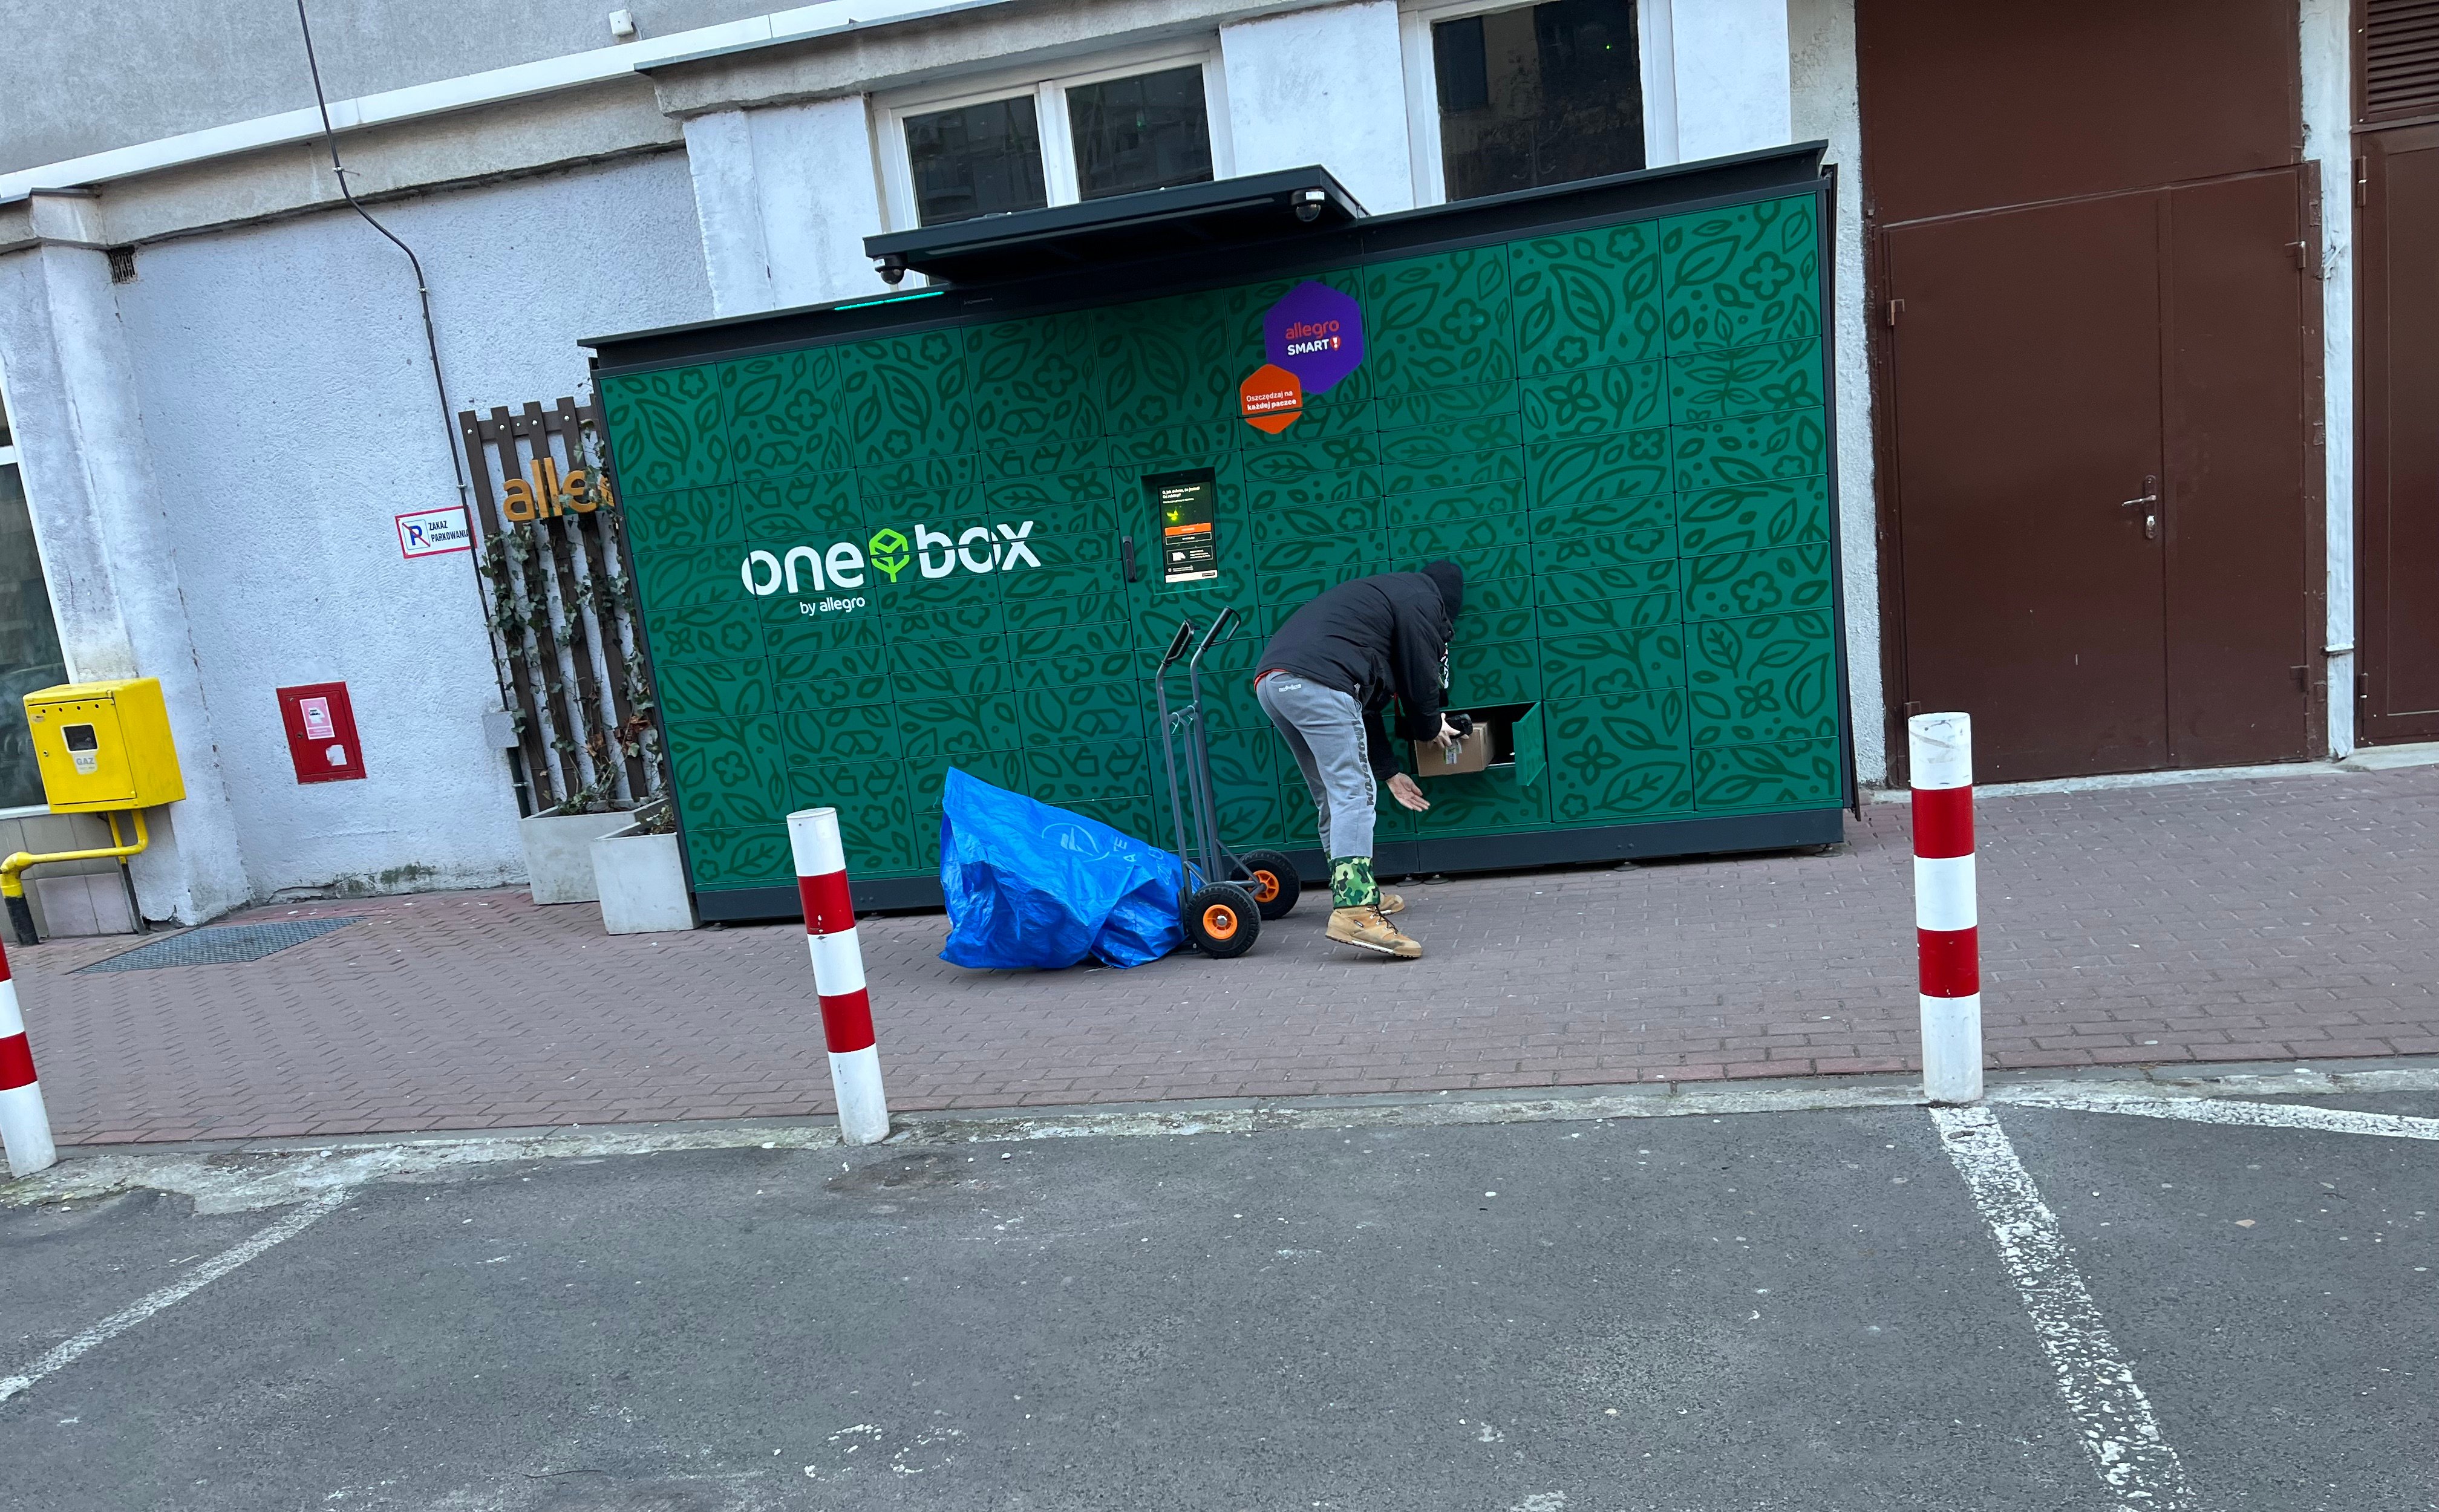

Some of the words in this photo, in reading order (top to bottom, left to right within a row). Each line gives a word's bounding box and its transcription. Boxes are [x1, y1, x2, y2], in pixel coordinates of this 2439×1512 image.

[1285, 320, 1339, 340] allegro
[1246, 391, 1283, 402] Oszczędzaj
[1247, 402, 1270, 411] każdej
[1272, 399, 1296, 409] paczce
[428, 521, 448, 531] ZAKAZ
[800, 601, 815, 616] by
[820, 597, 866, 613] allegro
